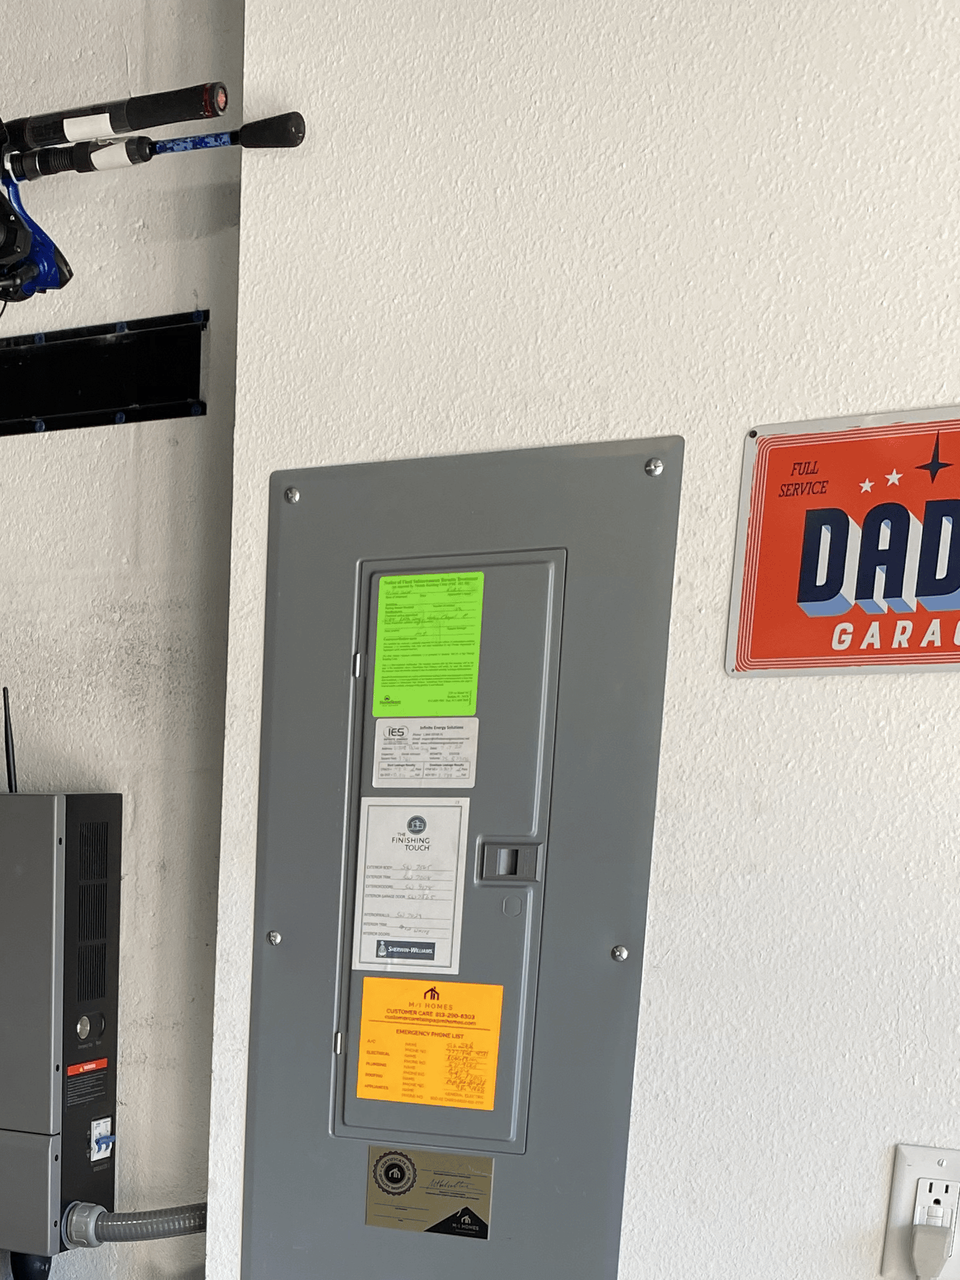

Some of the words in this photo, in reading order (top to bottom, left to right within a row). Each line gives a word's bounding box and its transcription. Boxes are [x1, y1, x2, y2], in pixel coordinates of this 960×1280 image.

[791, 461, 819, 476] FULL
[778, 480, 829, 498] SERVICE
[388, 727, 405, 737] IES
[424, 1003, 453, 1011] HOMES
[386, 1008, 417, 1016] CUSTOMER
[396, 1029, 430, 1037] EMERGENCY
